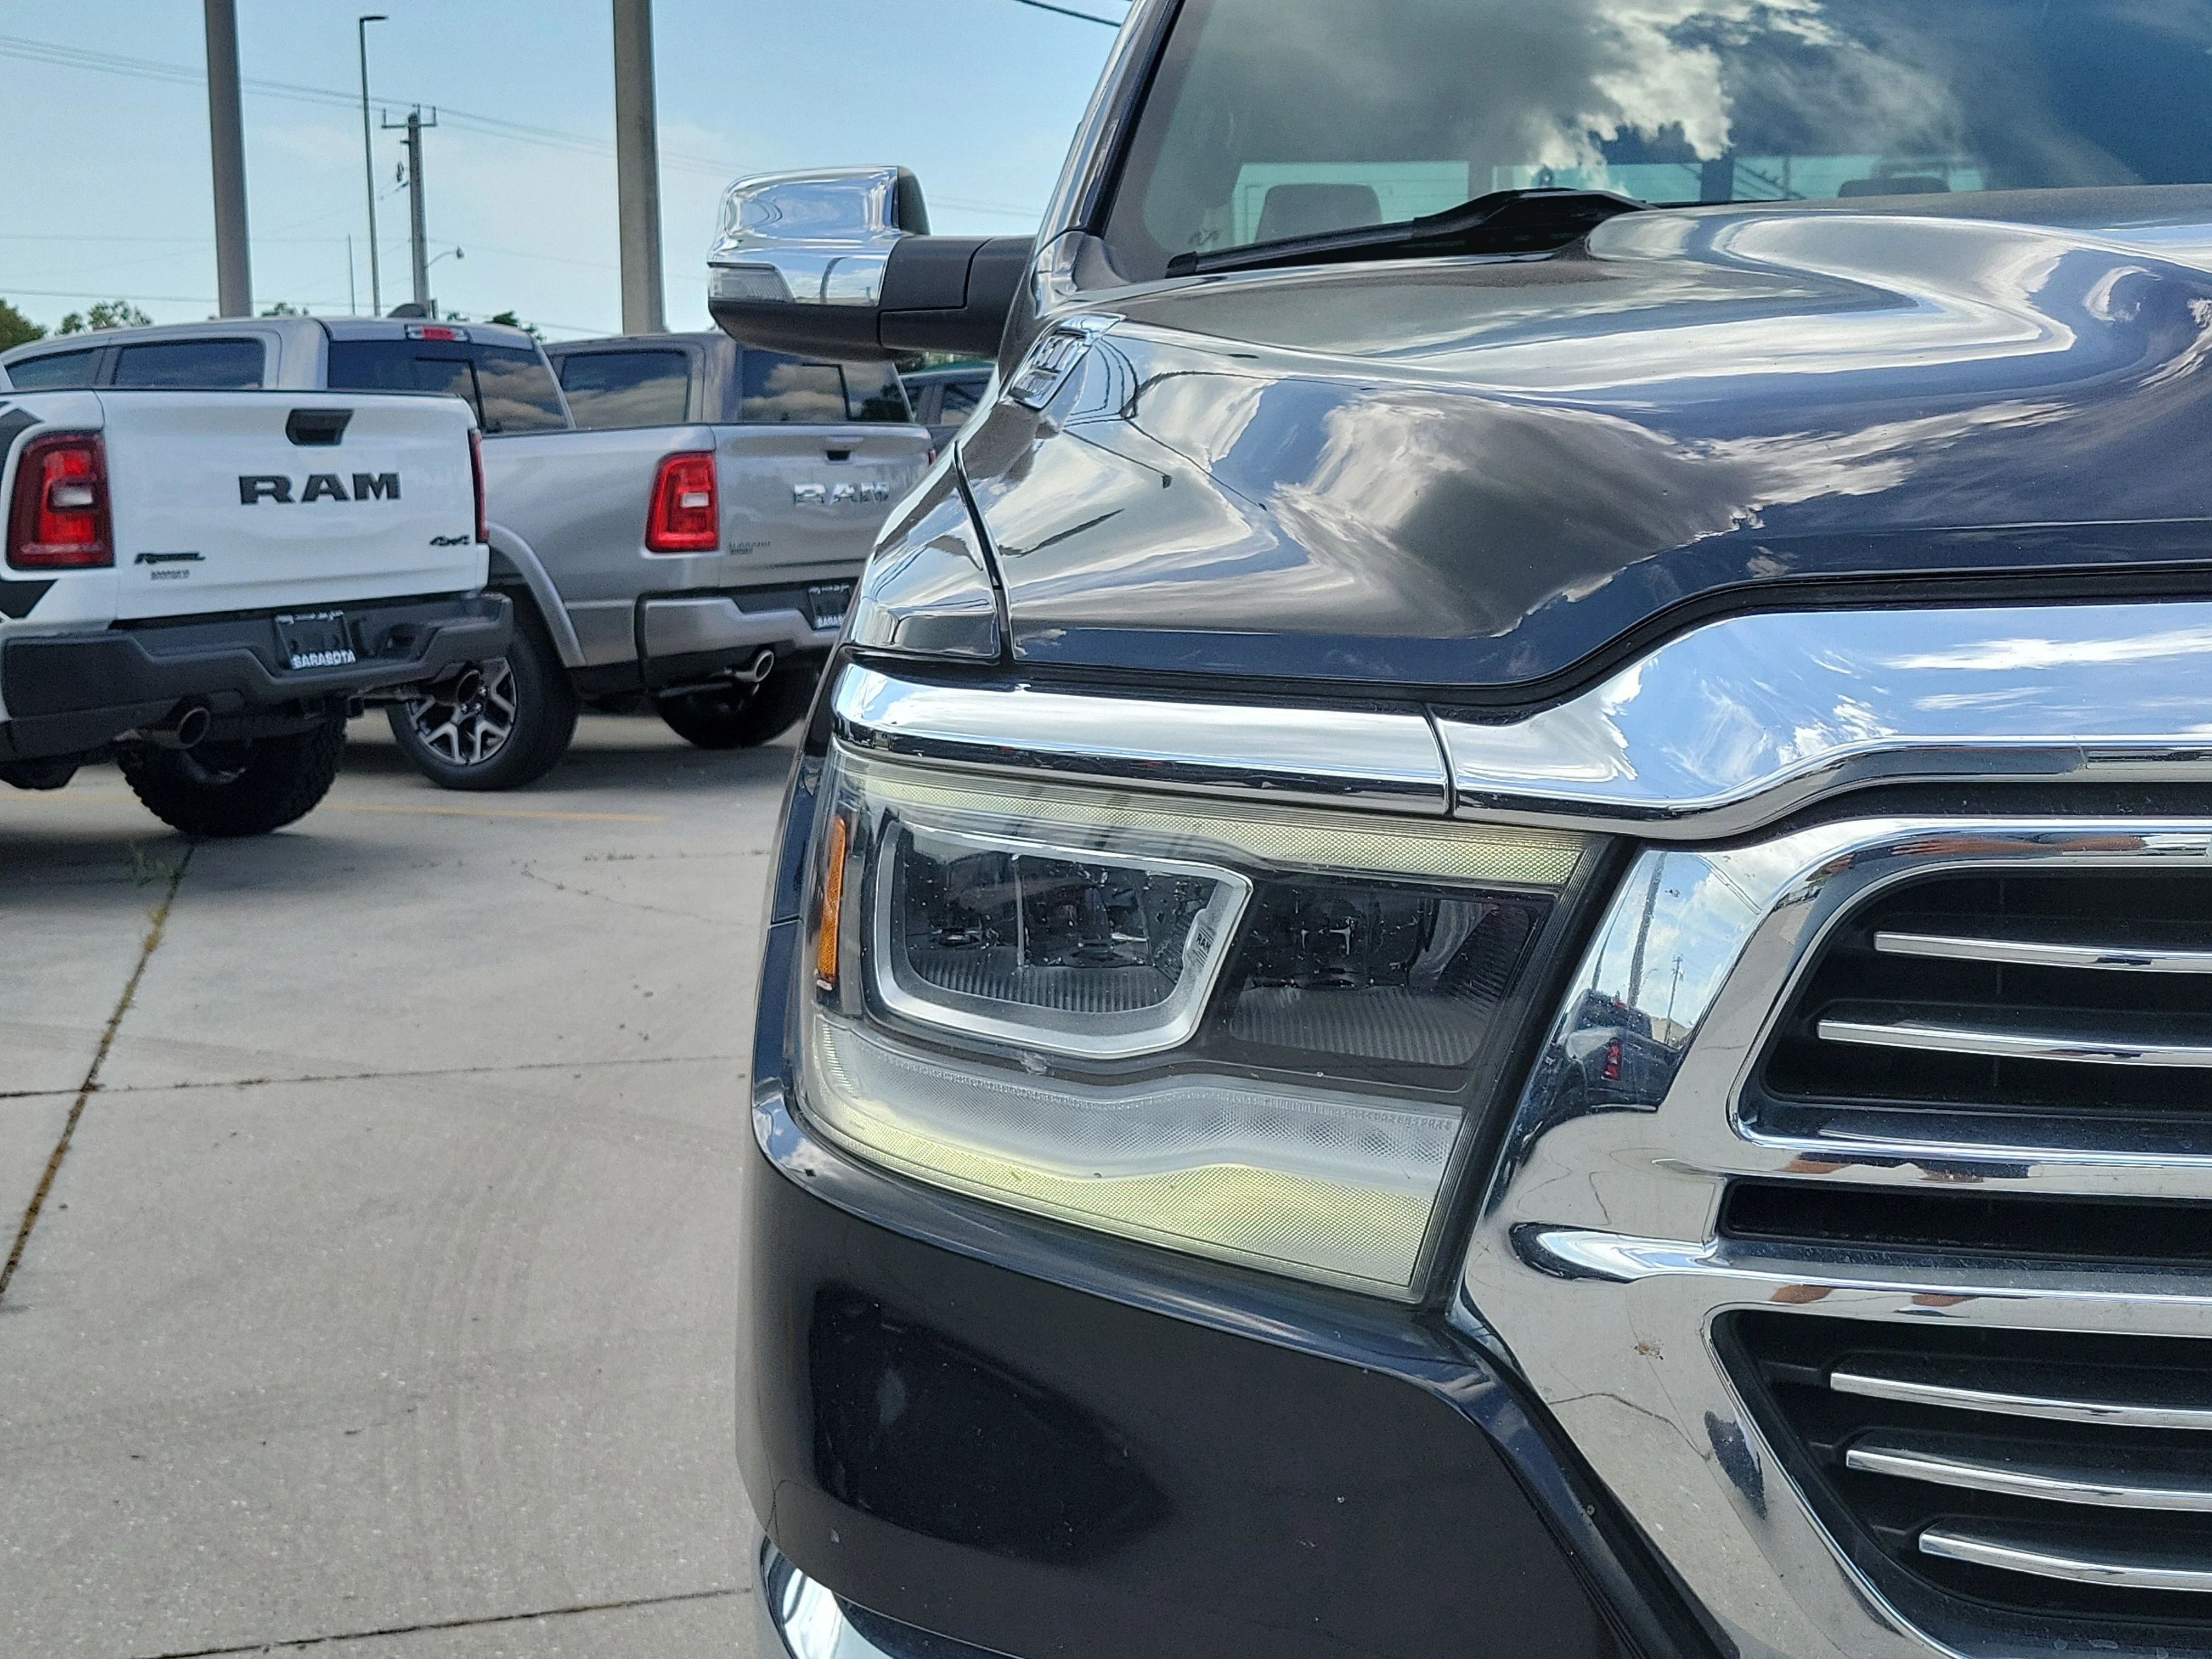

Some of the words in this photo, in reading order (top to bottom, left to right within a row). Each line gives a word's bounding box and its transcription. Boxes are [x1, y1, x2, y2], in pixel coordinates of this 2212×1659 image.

[239, 472, 401, 505] RAM
[793, 483, 889, 506] RAM
[291, 649, 356, 669] SARASOTA
[1197, 933, 1211, 954] RAM
